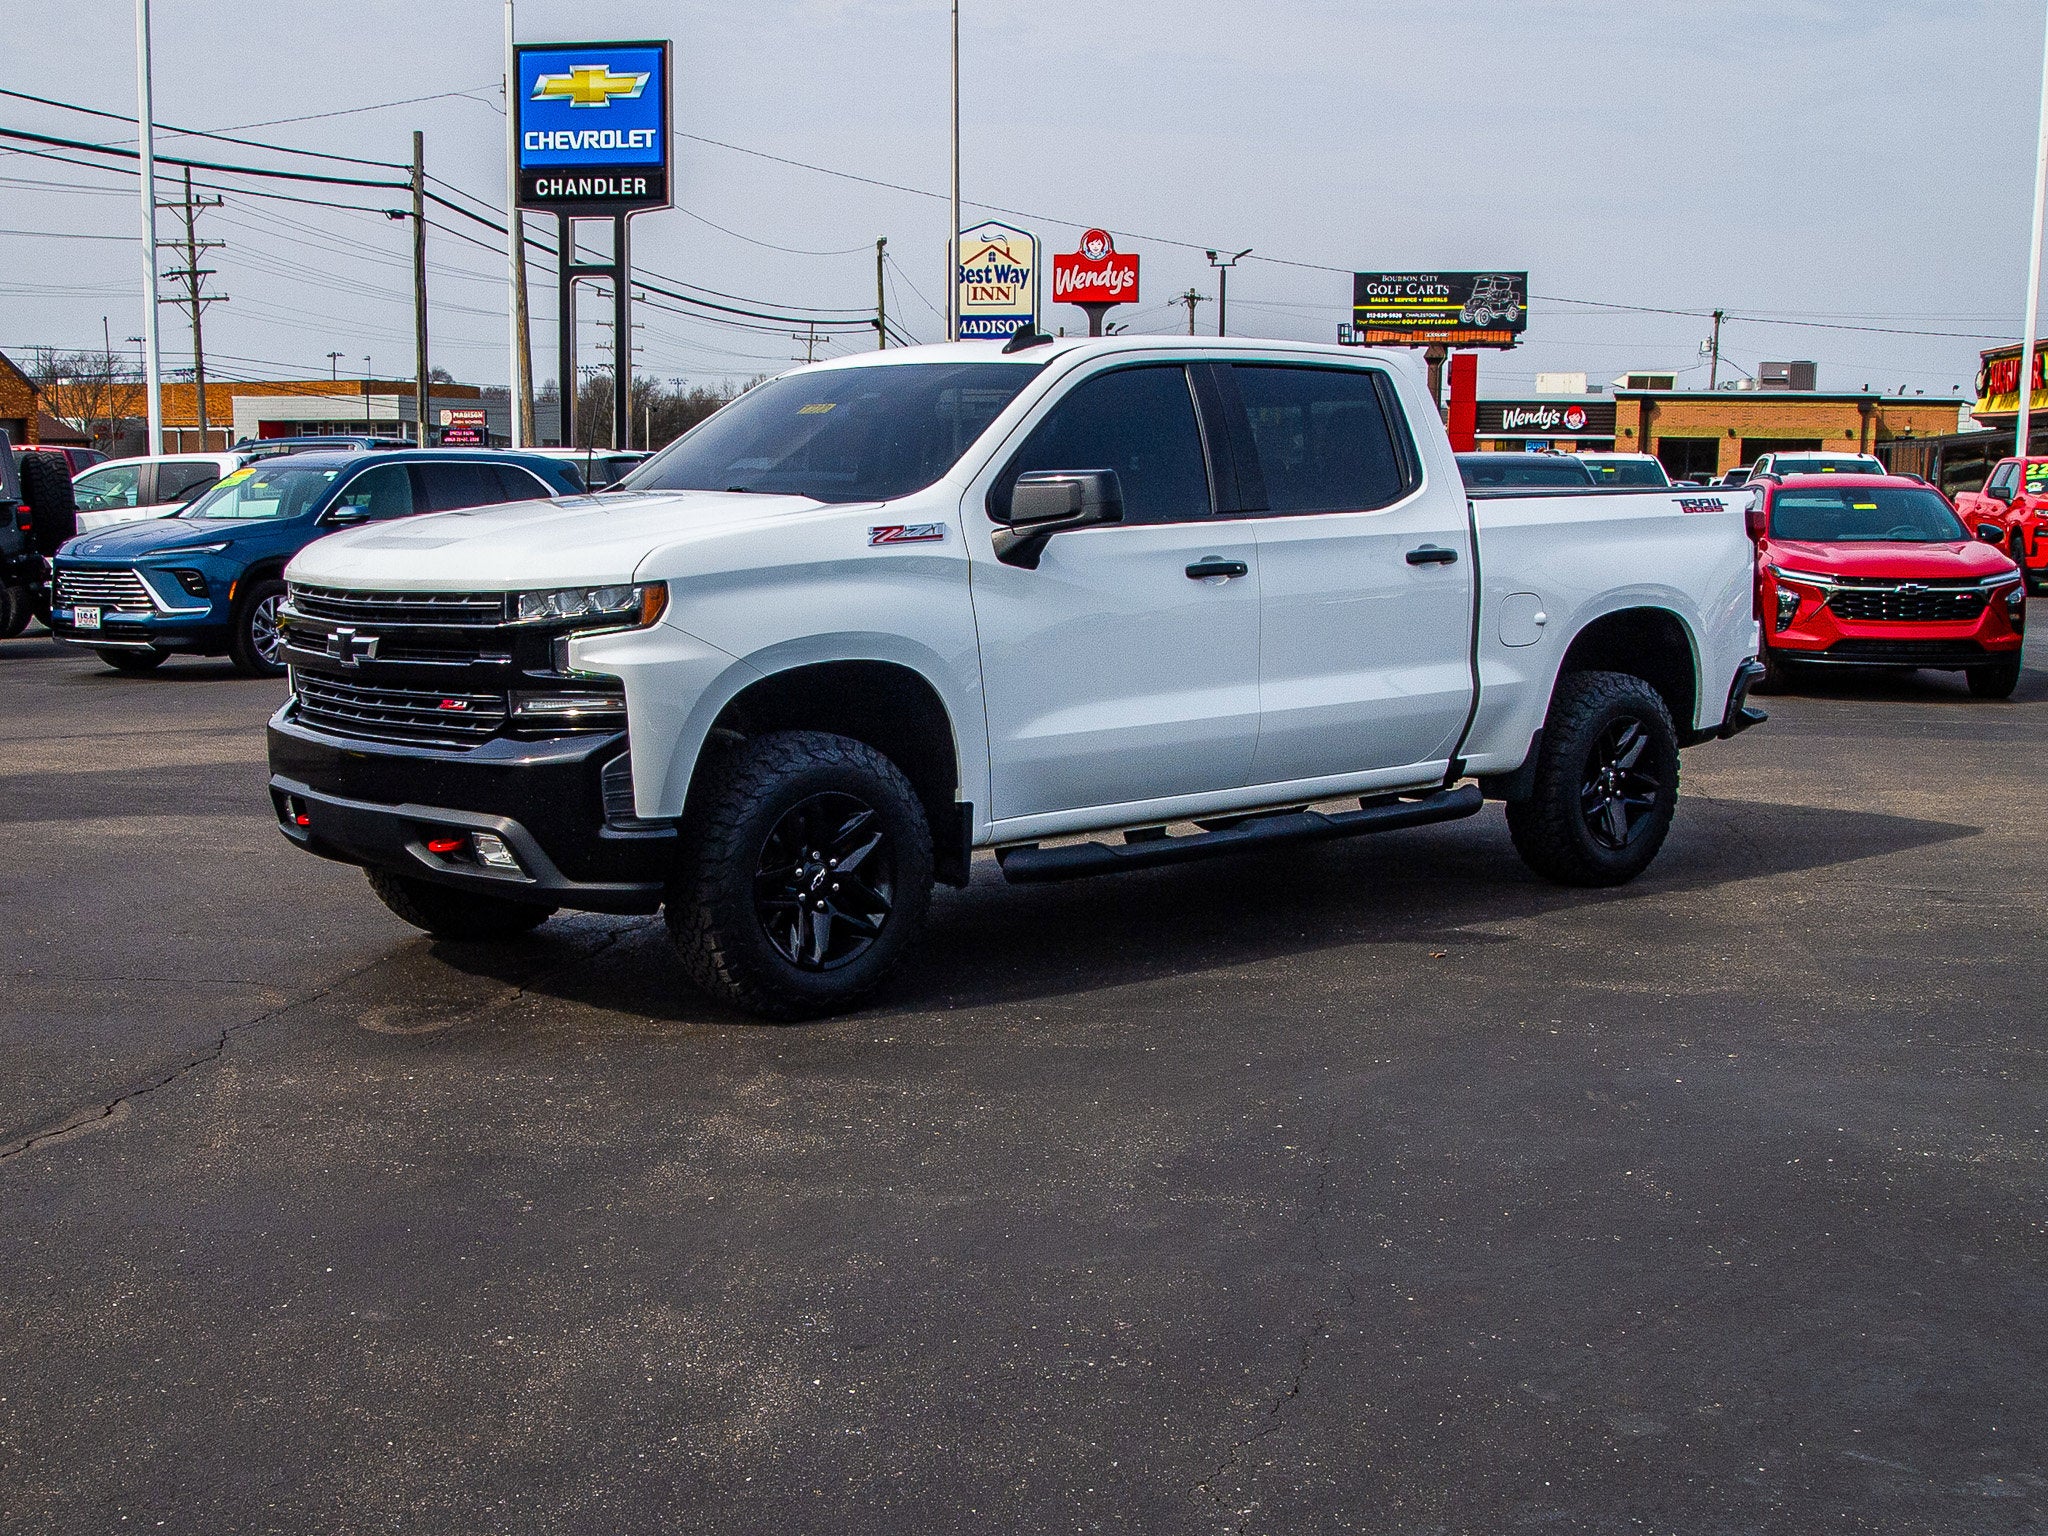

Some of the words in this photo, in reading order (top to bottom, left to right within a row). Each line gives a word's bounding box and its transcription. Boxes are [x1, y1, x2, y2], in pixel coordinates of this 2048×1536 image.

[524, 129, 656, 150] CHEVROLET
[536, 178, 647, 196] CHANDLER
[994, 264, 1030, 290] Way
[1056, 261, 1135, 295] Wendy's
[1381, 274, 1418, 282] BOURBON
[1420, 274, 1439, 282] CITY
[971, 286, 1011, 301] INN
[1366, 283, 1402, 295] GOLF
[1406, 283, 1450, 295] CARTS
[1503, 405, 1561, 430] Wendy's
[1671, 498, 1728, 508] TRAIL
